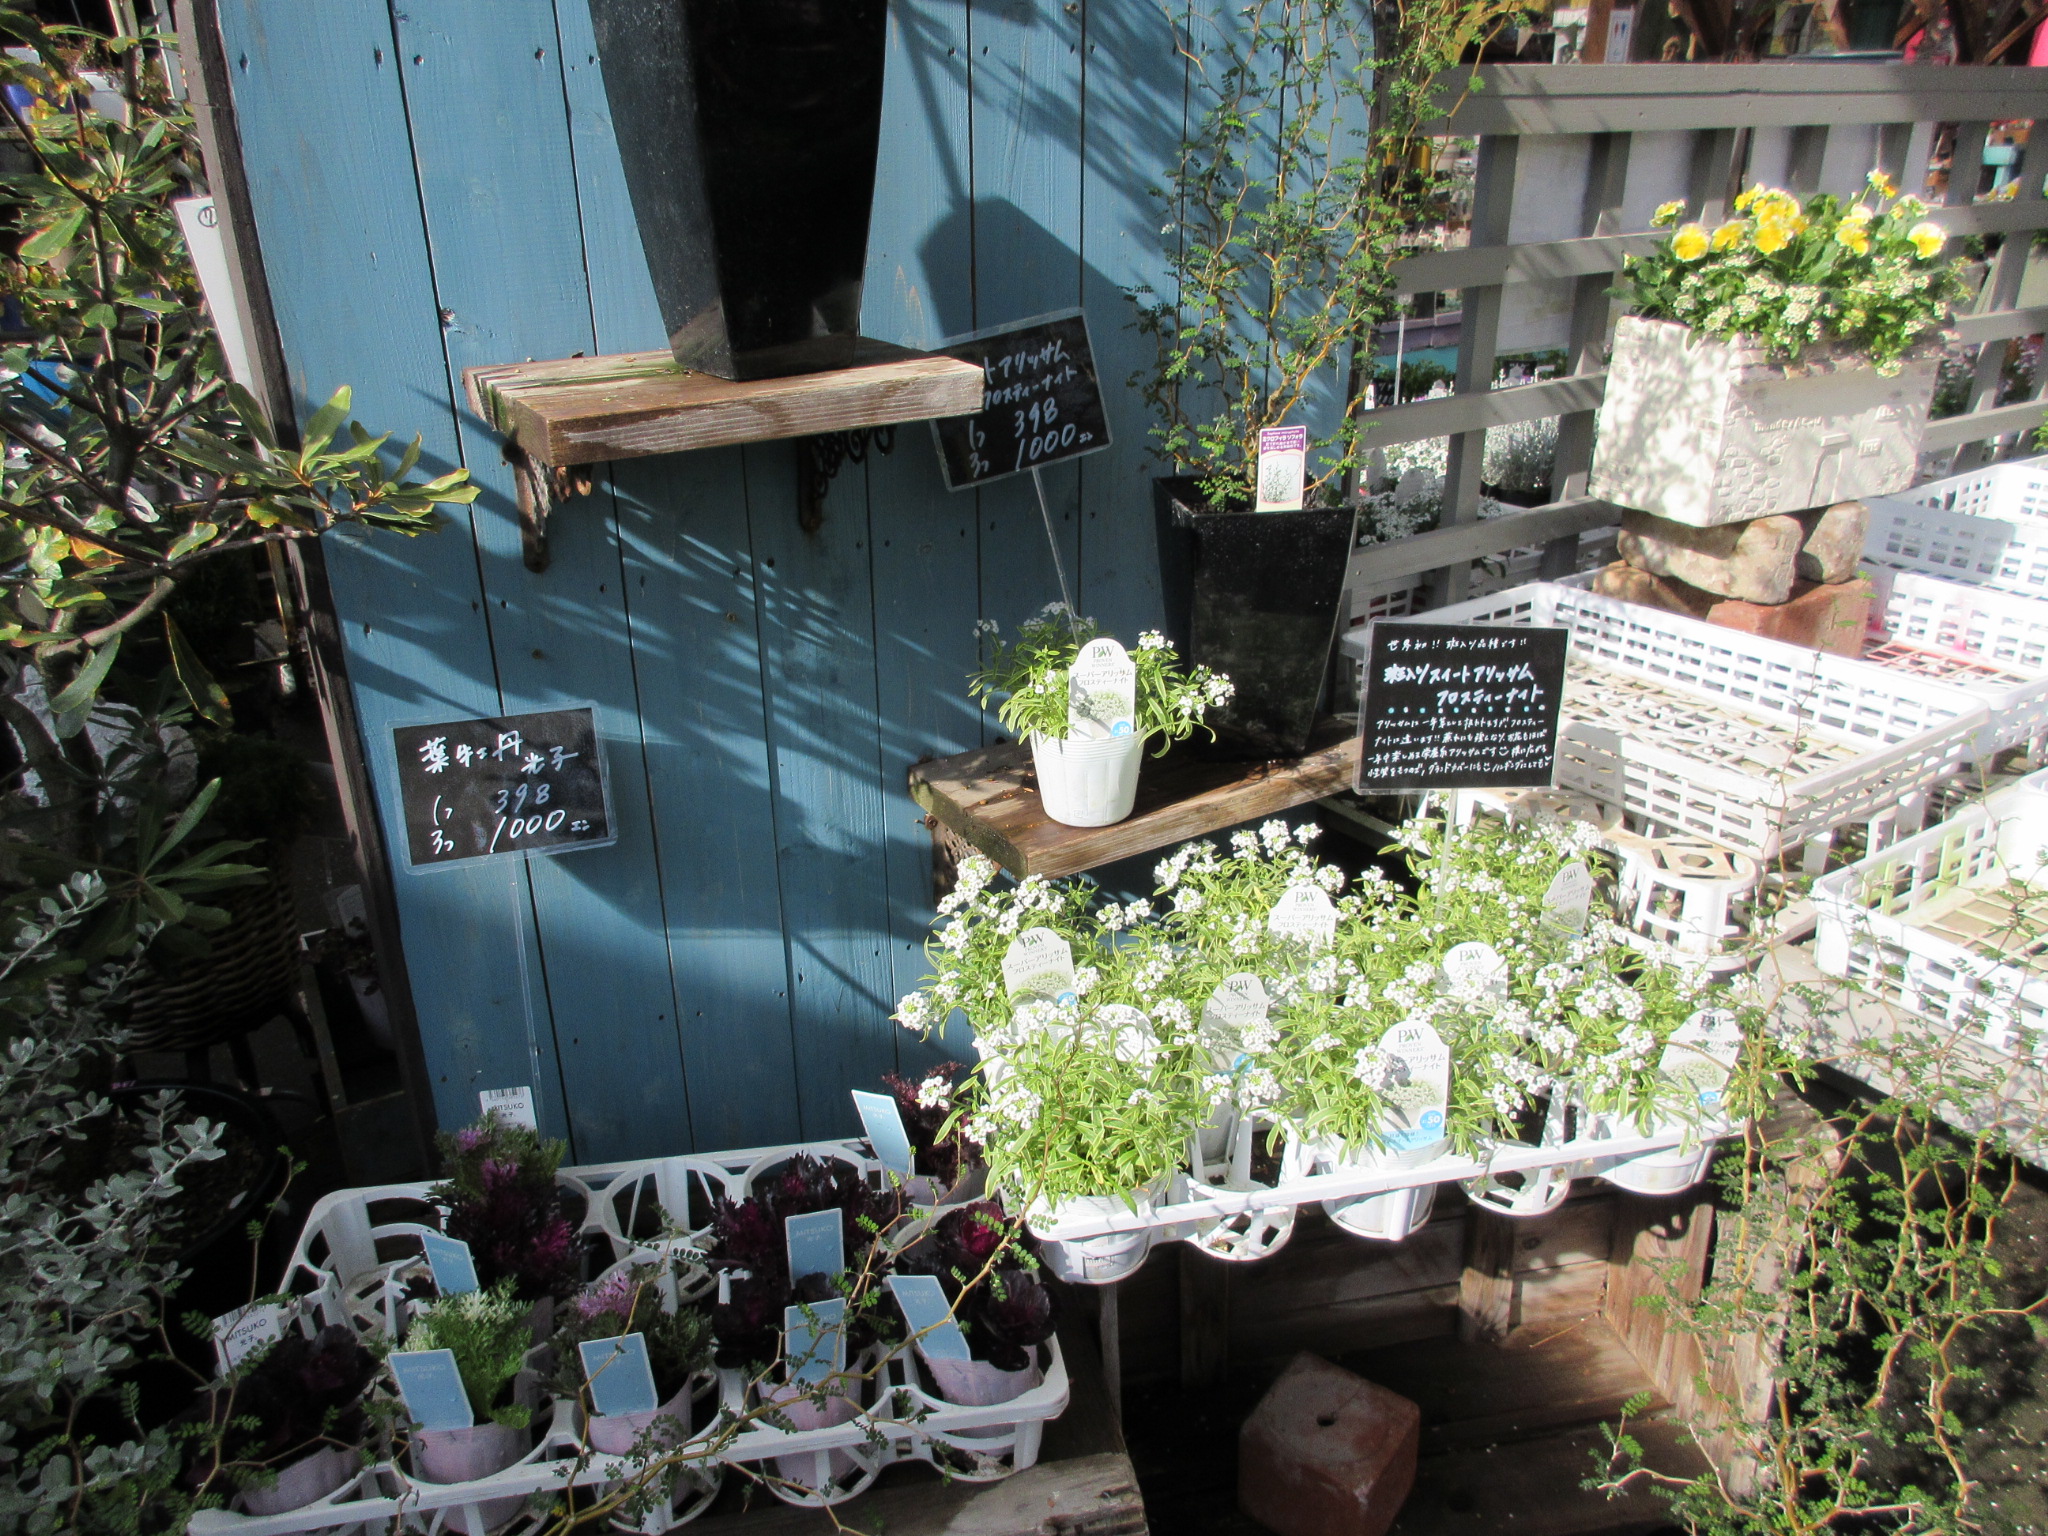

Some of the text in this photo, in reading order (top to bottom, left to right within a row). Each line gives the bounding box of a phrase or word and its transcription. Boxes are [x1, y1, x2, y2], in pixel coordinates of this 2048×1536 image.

[1014, 397, 1058, 438] 398
[1092, 645, 1114, 659] PW
[1437, 684, 1544, 706] フロスティーナイト
[495, 783, 550, 814] 398
[1295, 892, 1318, 902] PW
[1022, 932, 1044, 948] PW
[1459, 949, 1484, 961] PW
[1398, 1028, 1424, 1043] PW
[1427, 1115, 1441, 1124] 50
[796, 1224, 833, 1236] MITSUKO
[227, 1318, 267, 1342] MITSUKO
